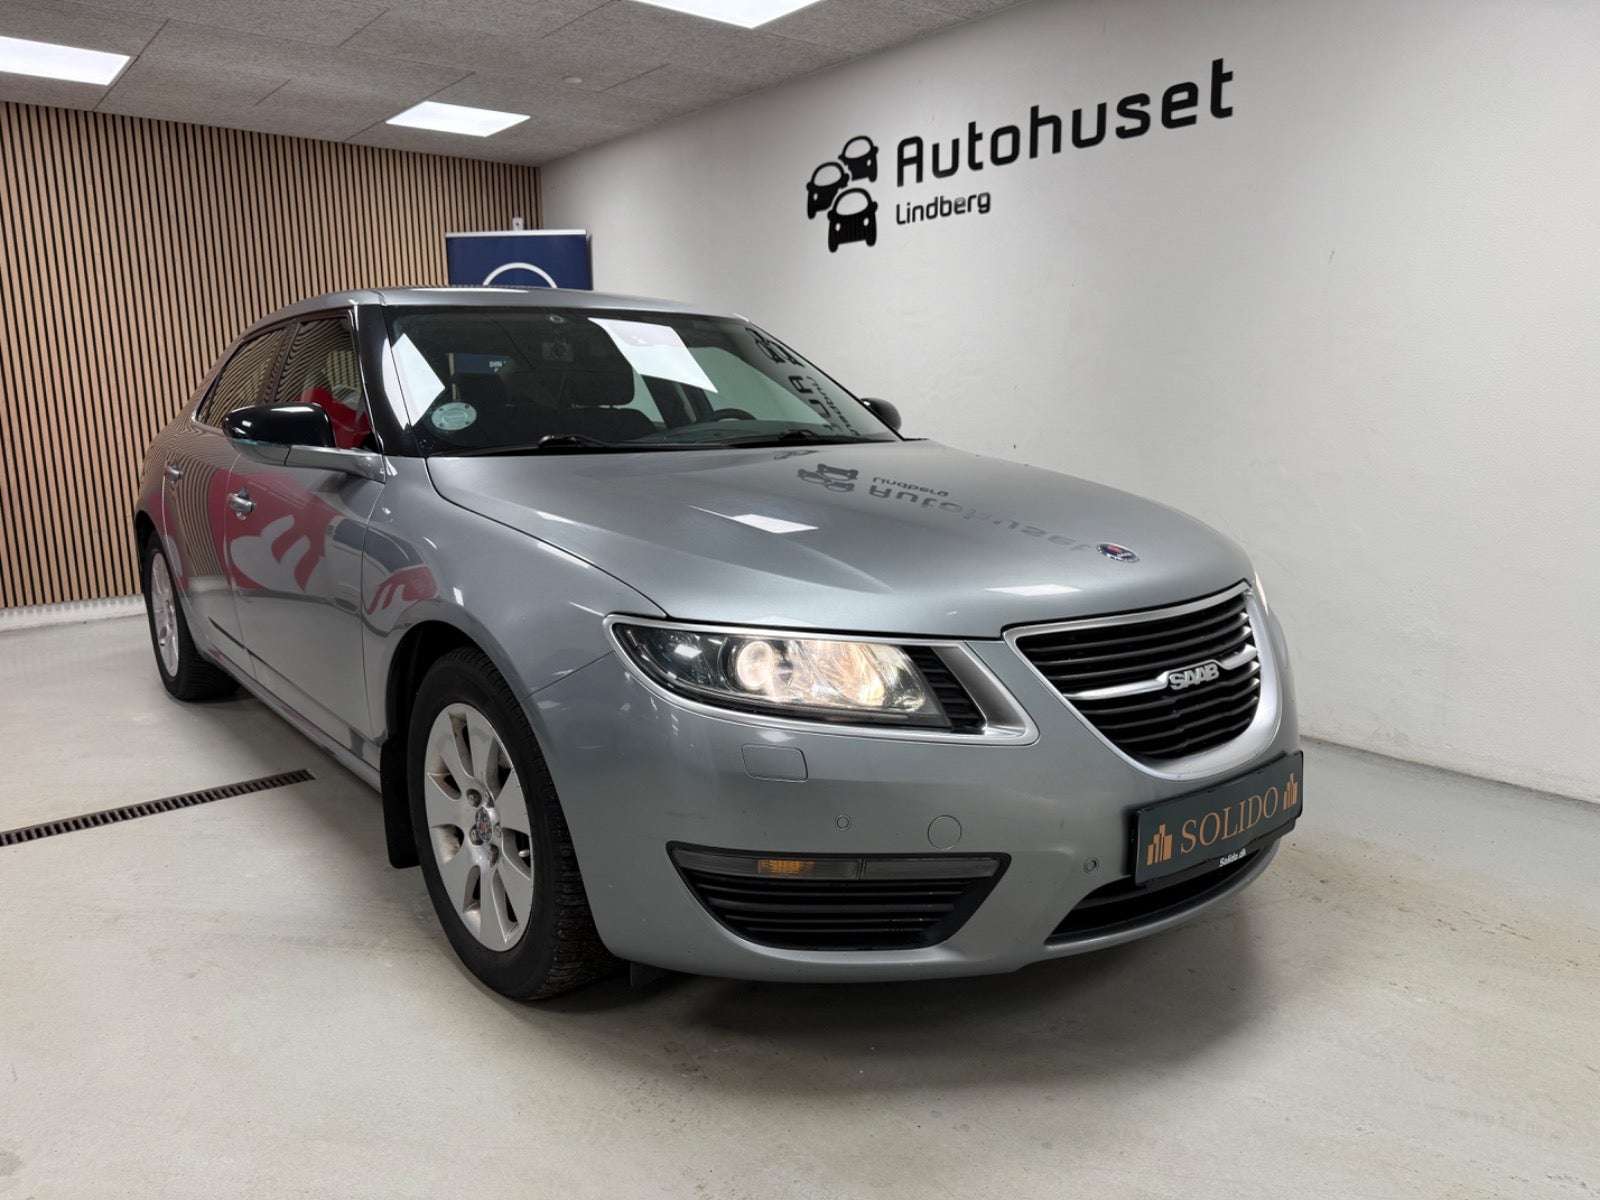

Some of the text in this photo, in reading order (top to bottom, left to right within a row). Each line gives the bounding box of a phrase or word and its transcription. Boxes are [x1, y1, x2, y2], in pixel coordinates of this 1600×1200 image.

[896, 58, 1234, 187] Autohuset
[896, 191, 991, 225] Lindberg
[1169, 663, 1219, 690] SAAB
[1180, 786, 1279, 854] SOLIDO
